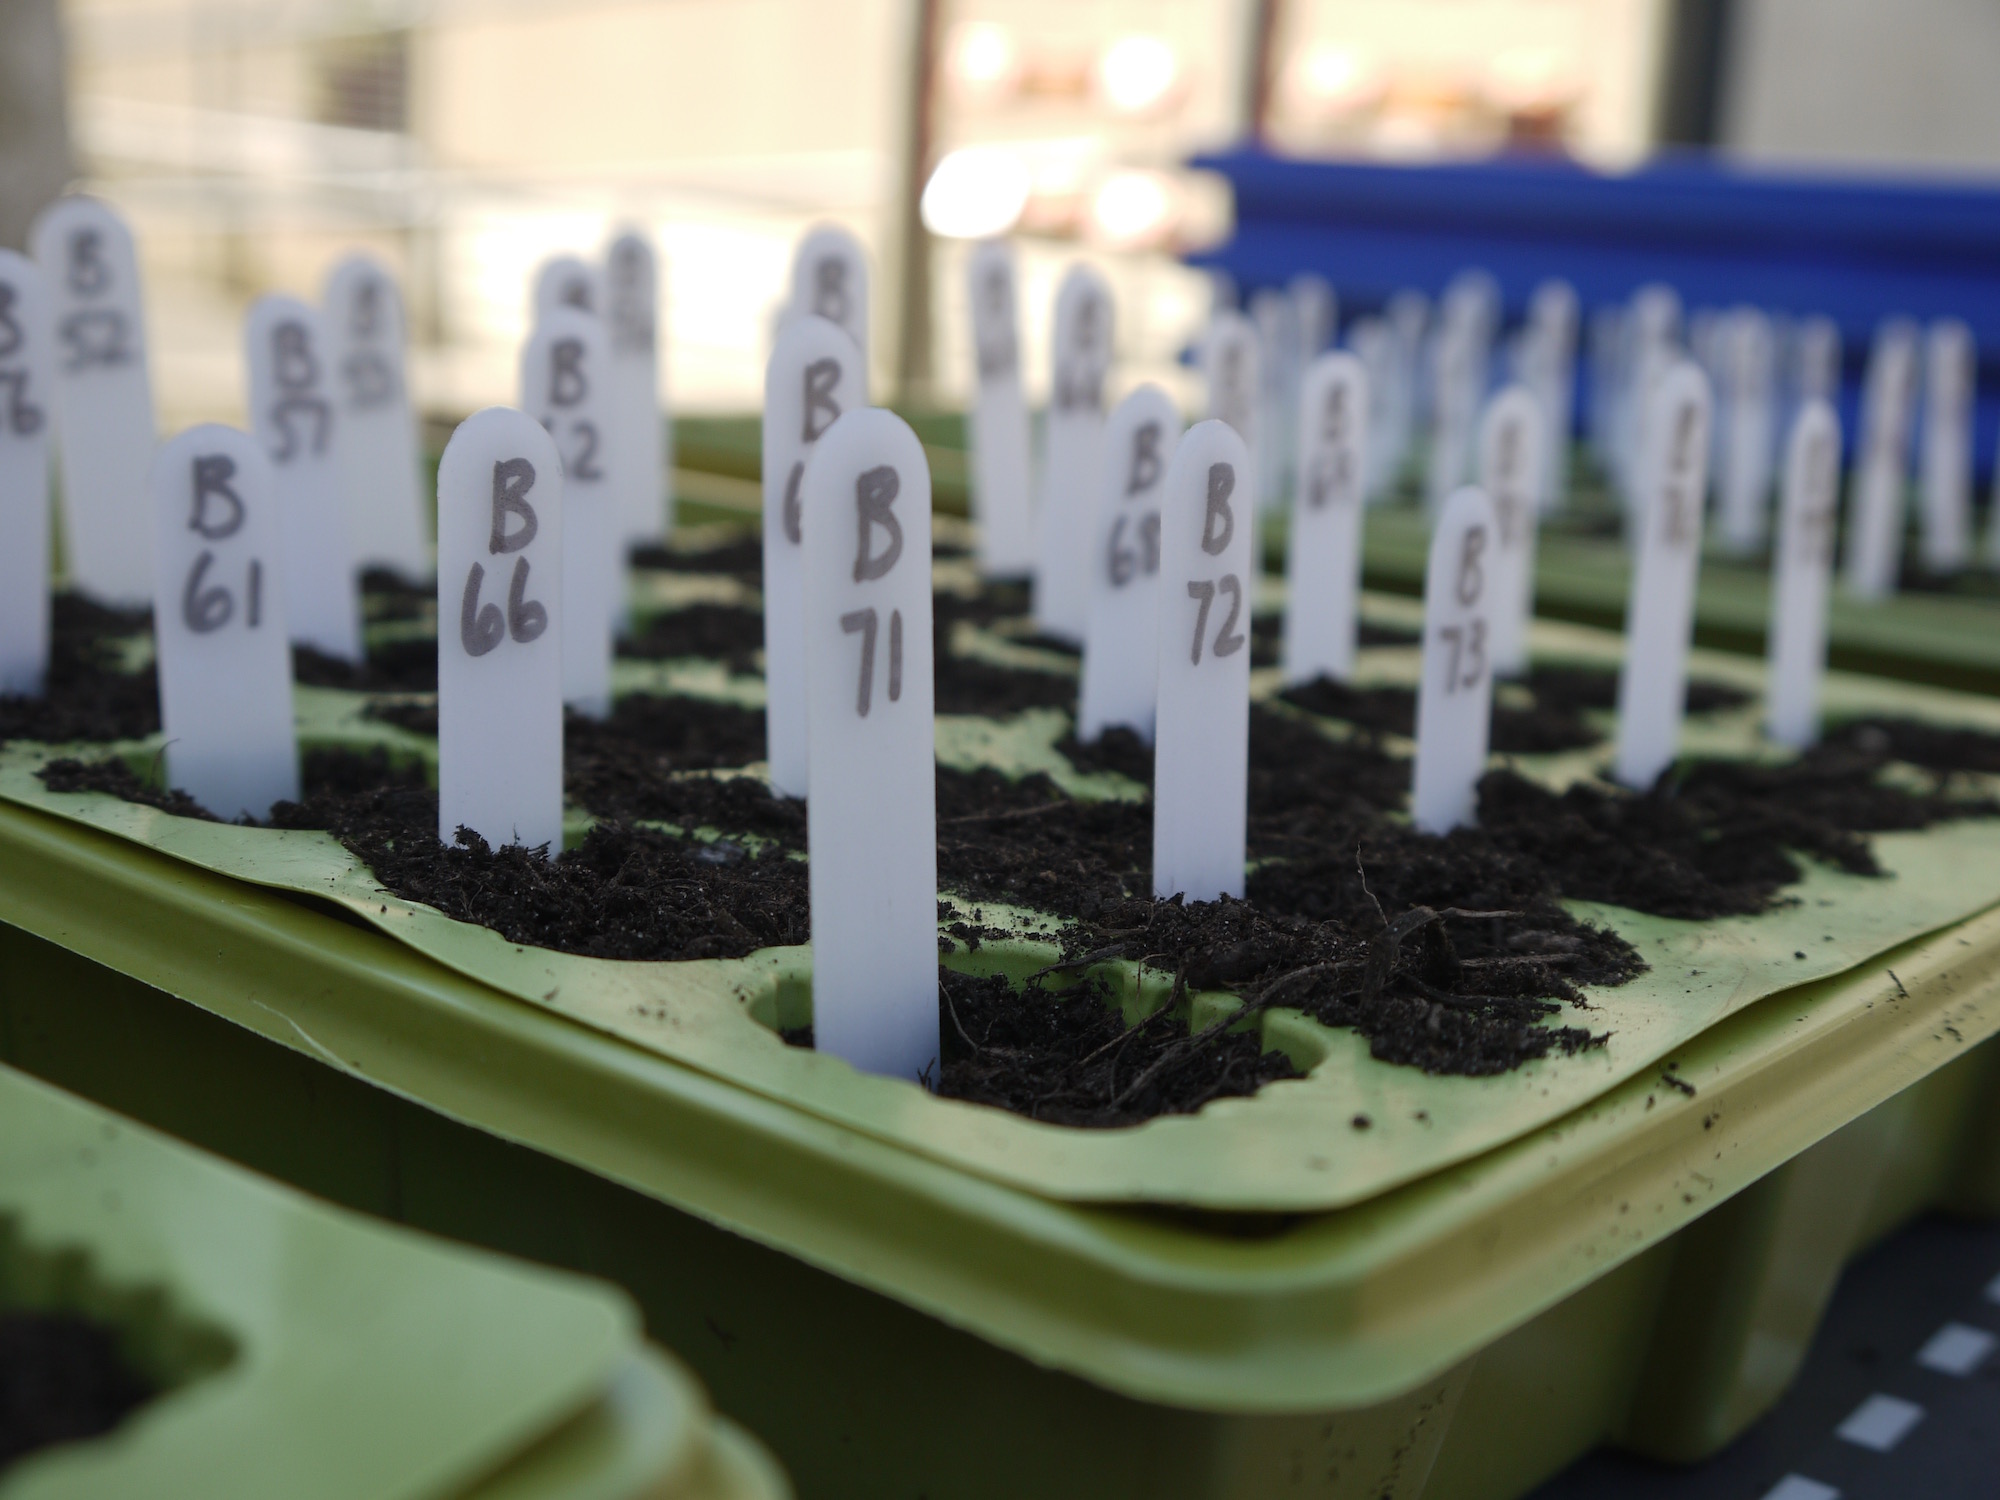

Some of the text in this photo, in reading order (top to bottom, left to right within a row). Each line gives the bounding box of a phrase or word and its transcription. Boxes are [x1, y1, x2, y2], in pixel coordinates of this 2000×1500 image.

[272, 321, 319, 394] B
[548, 337, 588, 408] B
[270, 398, 331, 463] 57
[803, 358, 842, 443] B
[189, 454, 246, 541] B
[1126, 420, 1163, 496] B
[490, 457, 538, 555] B
[852, 464, 904, 584] B
[1201, 462, 1235, 556] B
[182, 550, 262, 635] 61
[461, 556, 548, 657] 66
[1457, 524, 1487, 608] B
[1187, 573, 1245, 666] 72
[1439, 618, 1488, 694] 73
[839, 607, 903, 718] 71
